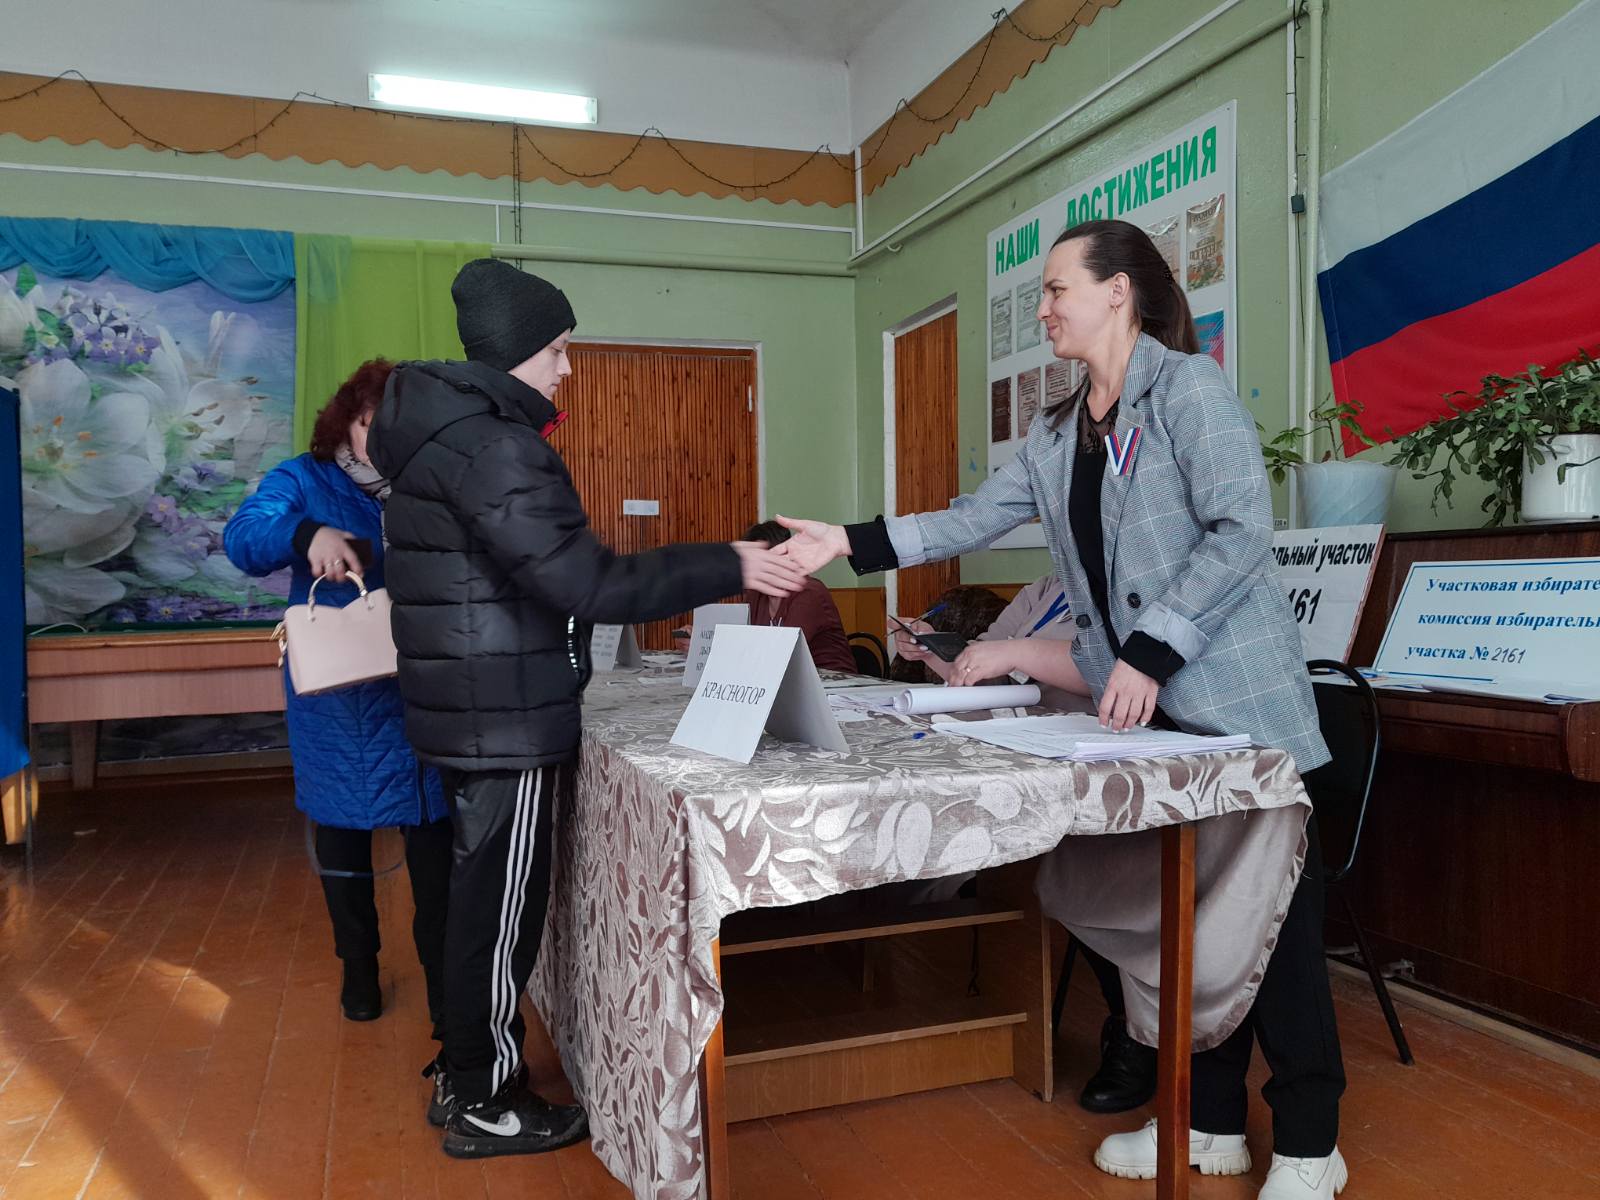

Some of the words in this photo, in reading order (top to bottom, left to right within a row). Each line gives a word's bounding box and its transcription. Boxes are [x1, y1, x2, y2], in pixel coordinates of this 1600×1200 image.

[995, 218, 1039, 276] НАШИ
[1066, 126, 1217, 230] ДОСТИЖЕНИЯ
[1315, 542, 1377, 573] участок
[1426, 578, 1518, 592] Участковая
[1522, 577, 1600, 595] избирате
[1417, 614, 1492, 626] комиссия
[1404, 646, 1466, 660] участка
[1469, 646, 1489, 661] №
[1491, 647, 1526, 664] 2161
[702, 681, 766, 705] КРАСНОГОР
